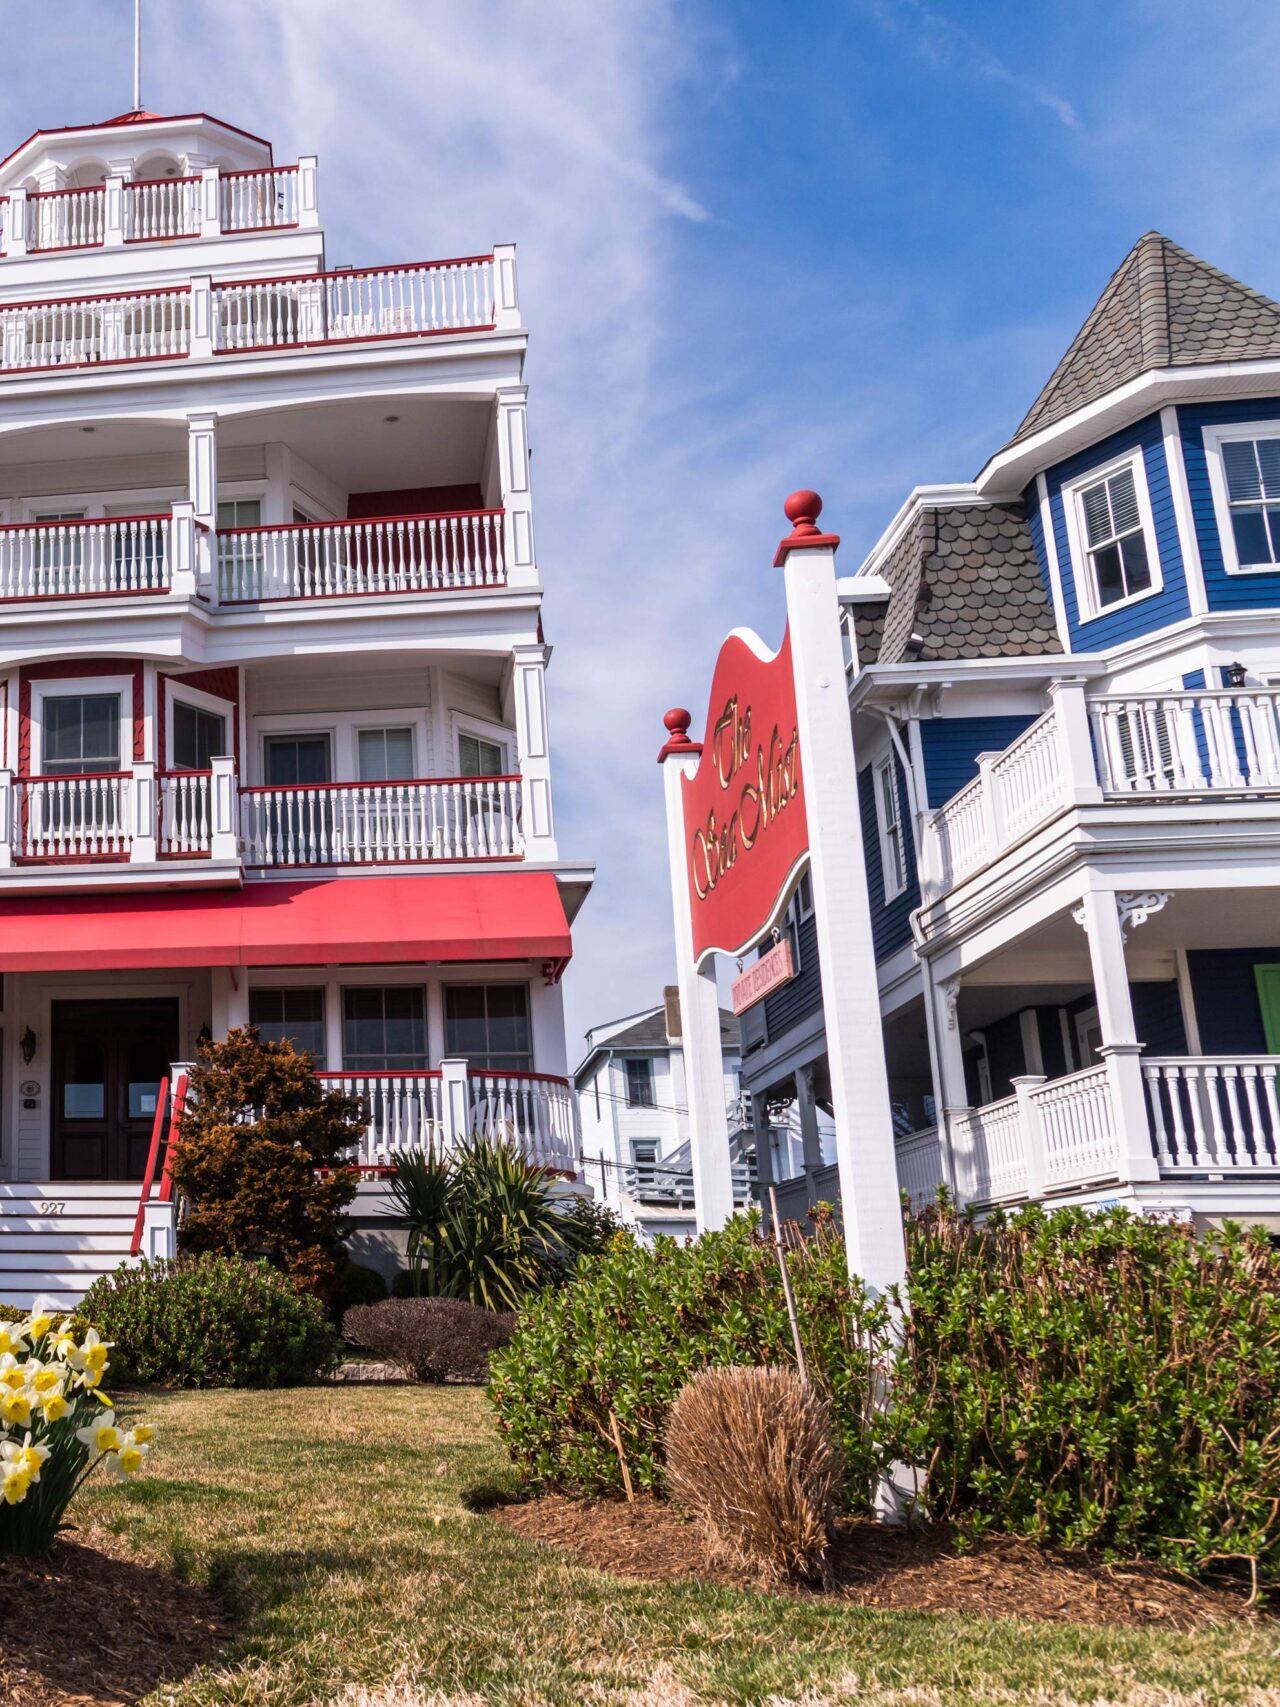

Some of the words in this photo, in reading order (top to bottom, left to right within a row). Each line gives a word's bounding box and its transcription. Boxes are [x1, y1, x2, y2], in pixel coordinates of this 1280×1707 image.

[712, 692, 752, 790] The
[692, 806, 738, 900] Sea
[739, 722, 799, 850] Mist
[40, 1202, 66, 1216] 927
